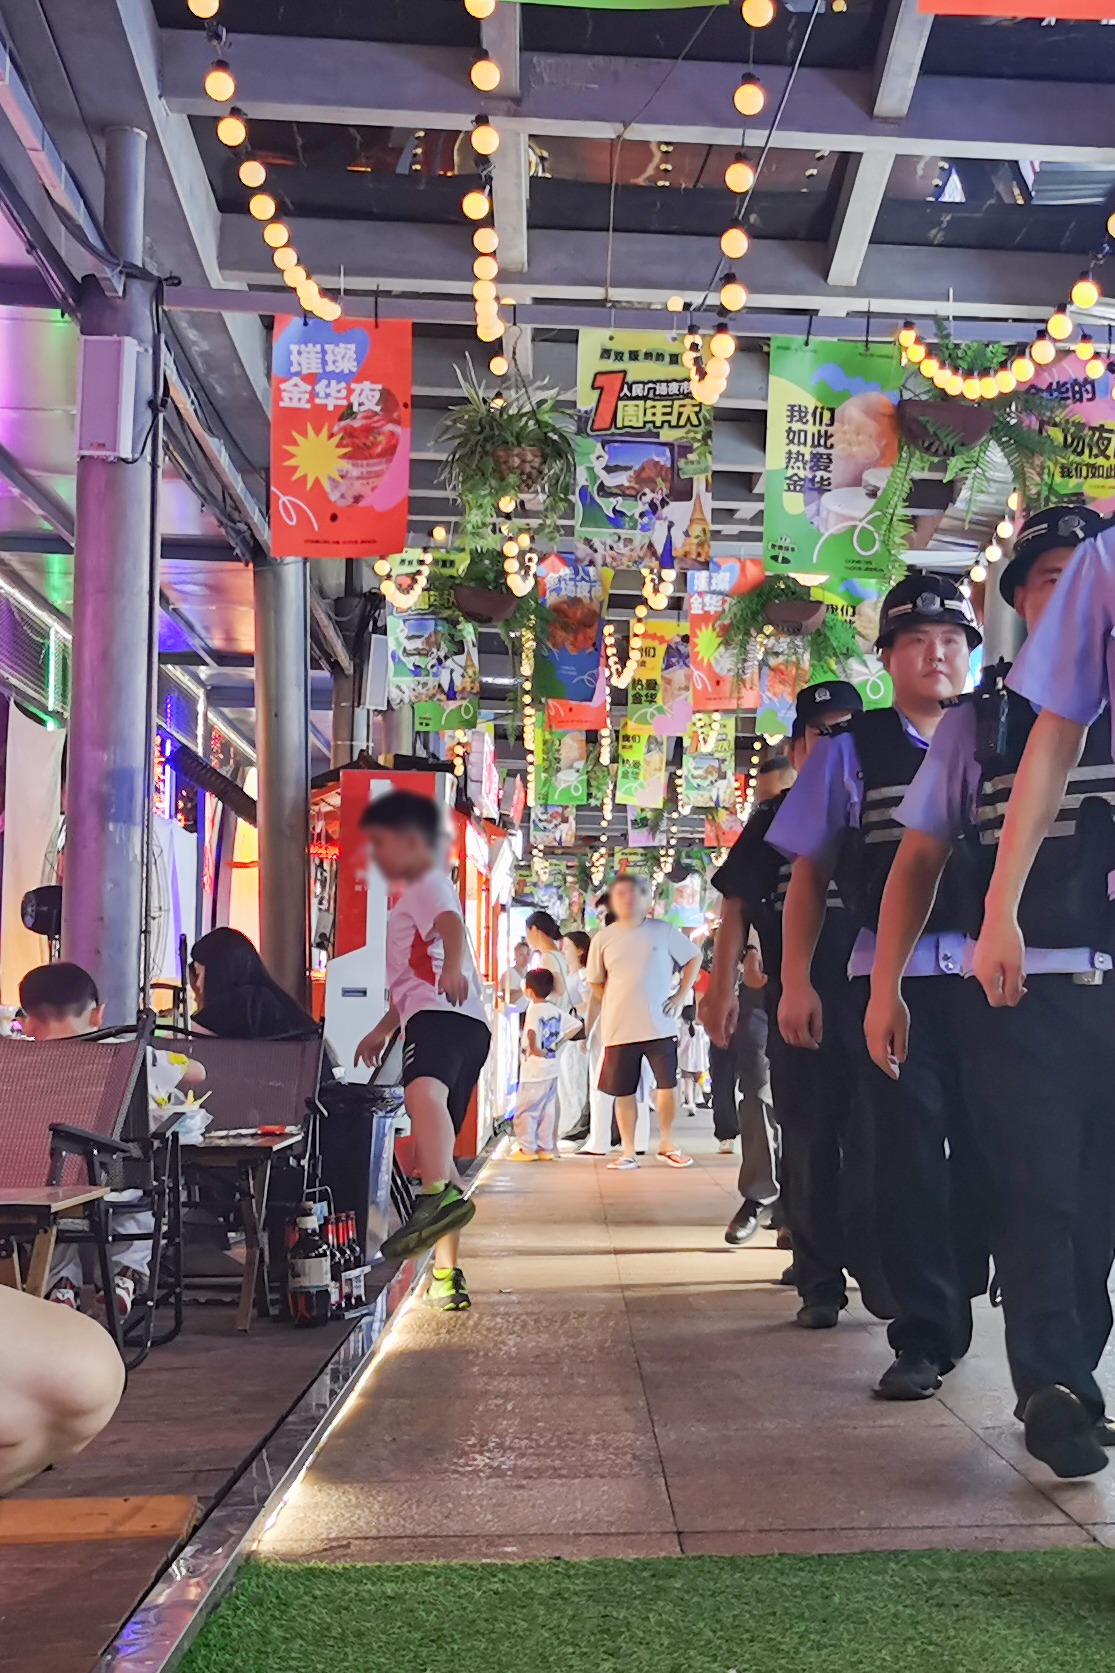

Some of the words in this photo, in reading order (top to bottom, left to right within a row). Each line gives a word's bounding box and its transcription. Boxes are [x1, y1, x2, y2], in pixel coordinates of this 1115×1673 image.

[290, 343, 358, 374] 璀璨
[279, 376, 383, 413] 金华夜
[615, 399, 701, 428] 周年庆
[785, 403, 836, 428] 我们
[785, 427, 835, 450] 如此
[784, 449, 833, 474] 热爱
[784, 473, 832, 494] 金华
